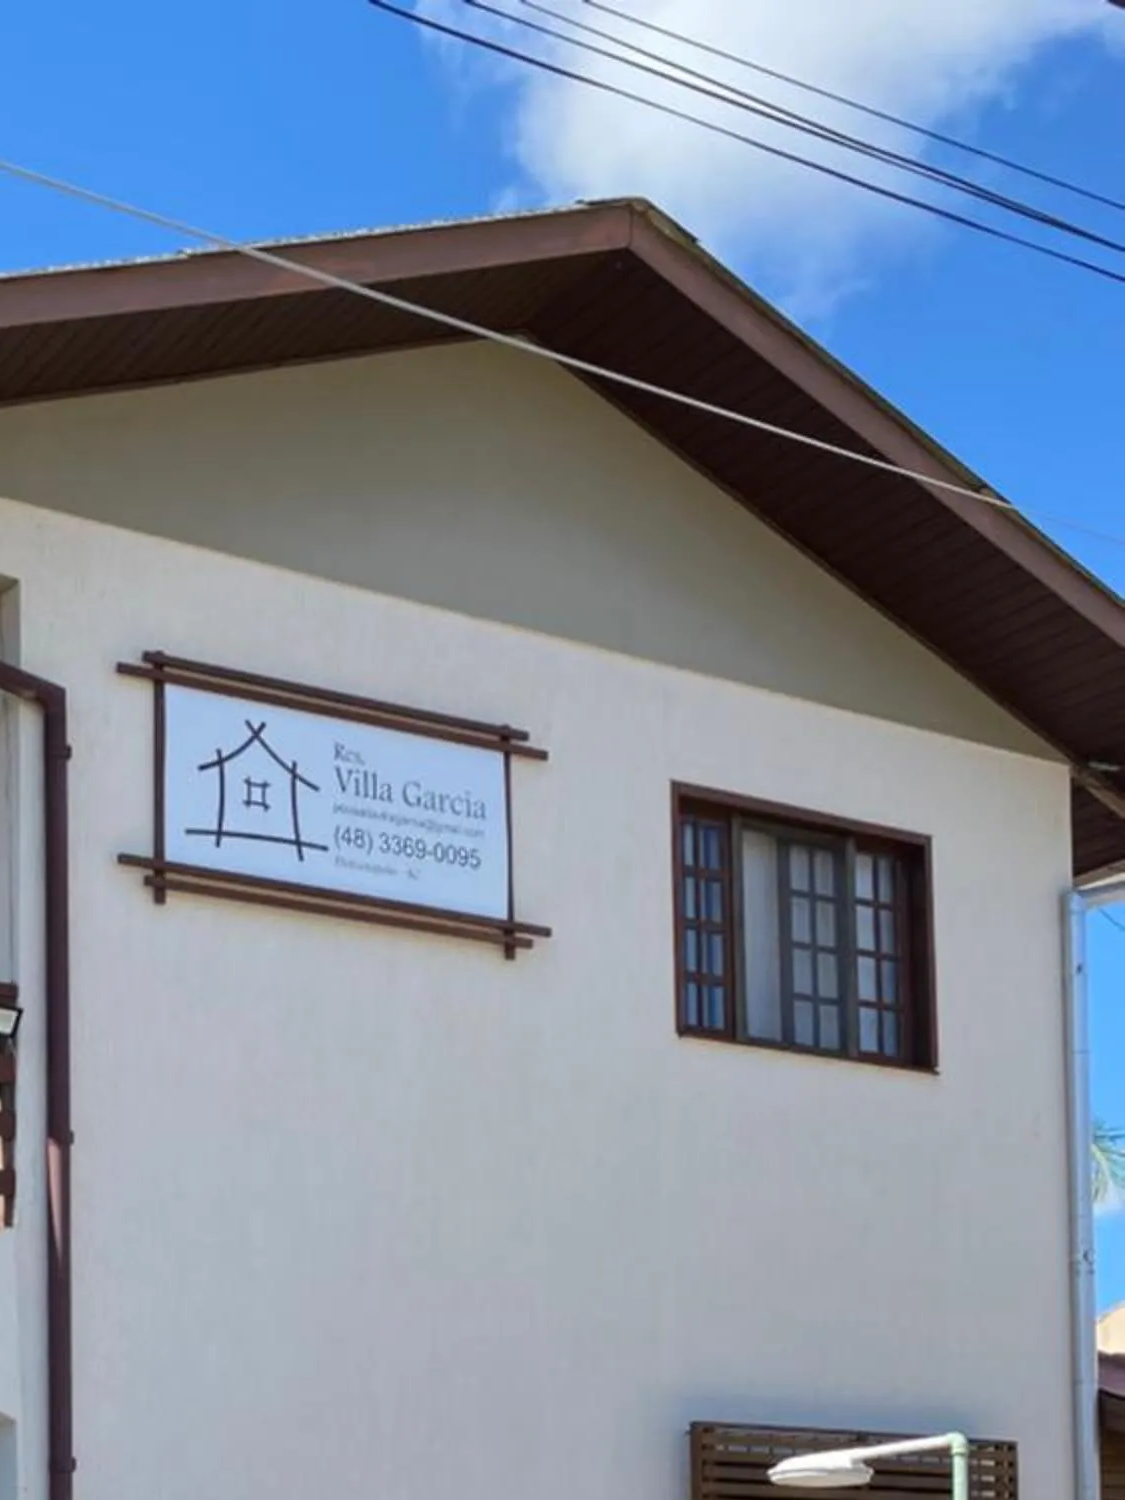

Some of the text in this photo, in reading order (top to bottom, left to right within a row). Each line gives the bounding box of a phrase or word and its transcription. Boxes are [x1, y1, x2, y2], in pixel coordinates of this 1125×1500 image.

[334, 766, 393, 803] Villa
[402, 780, 487, 820] Garcia
[333, 824, 374, 856] (48)
[379, 831, 482, 871] 3369-0095
